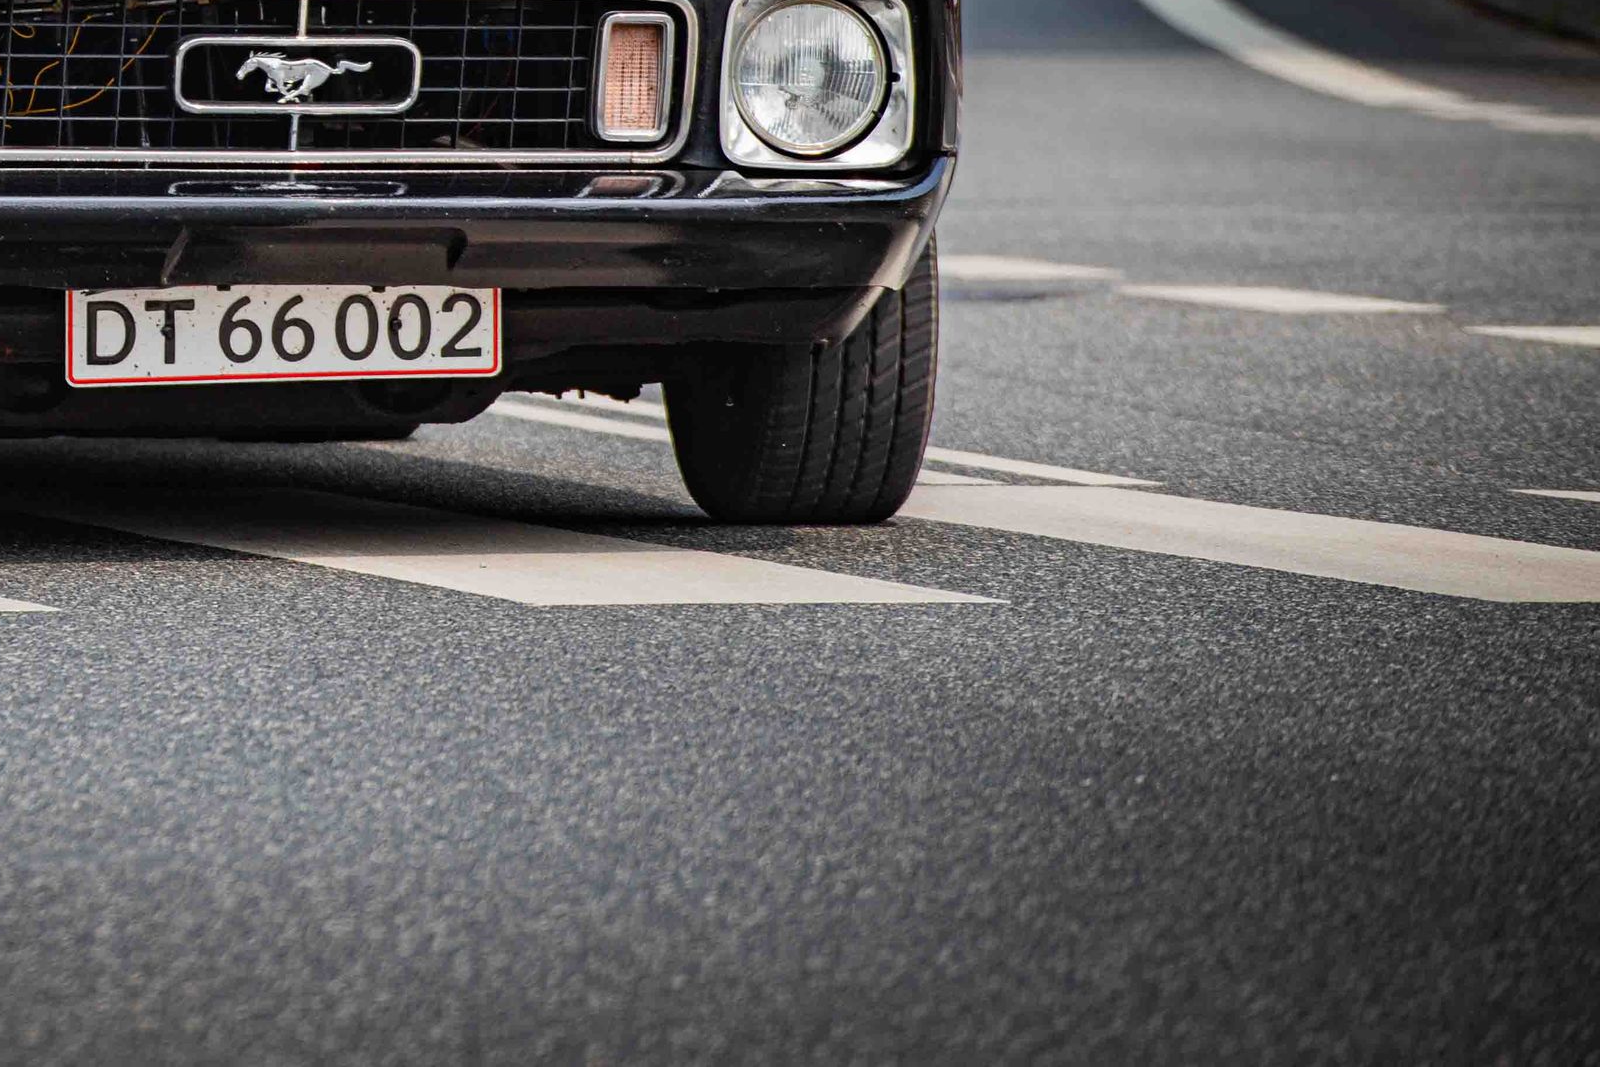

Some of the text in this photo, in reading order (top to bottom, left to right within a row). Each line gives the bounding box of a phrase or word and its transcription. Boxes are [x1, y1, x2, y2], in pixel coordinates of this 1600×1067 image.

[86, 292, 483, 366] DT 66 002
